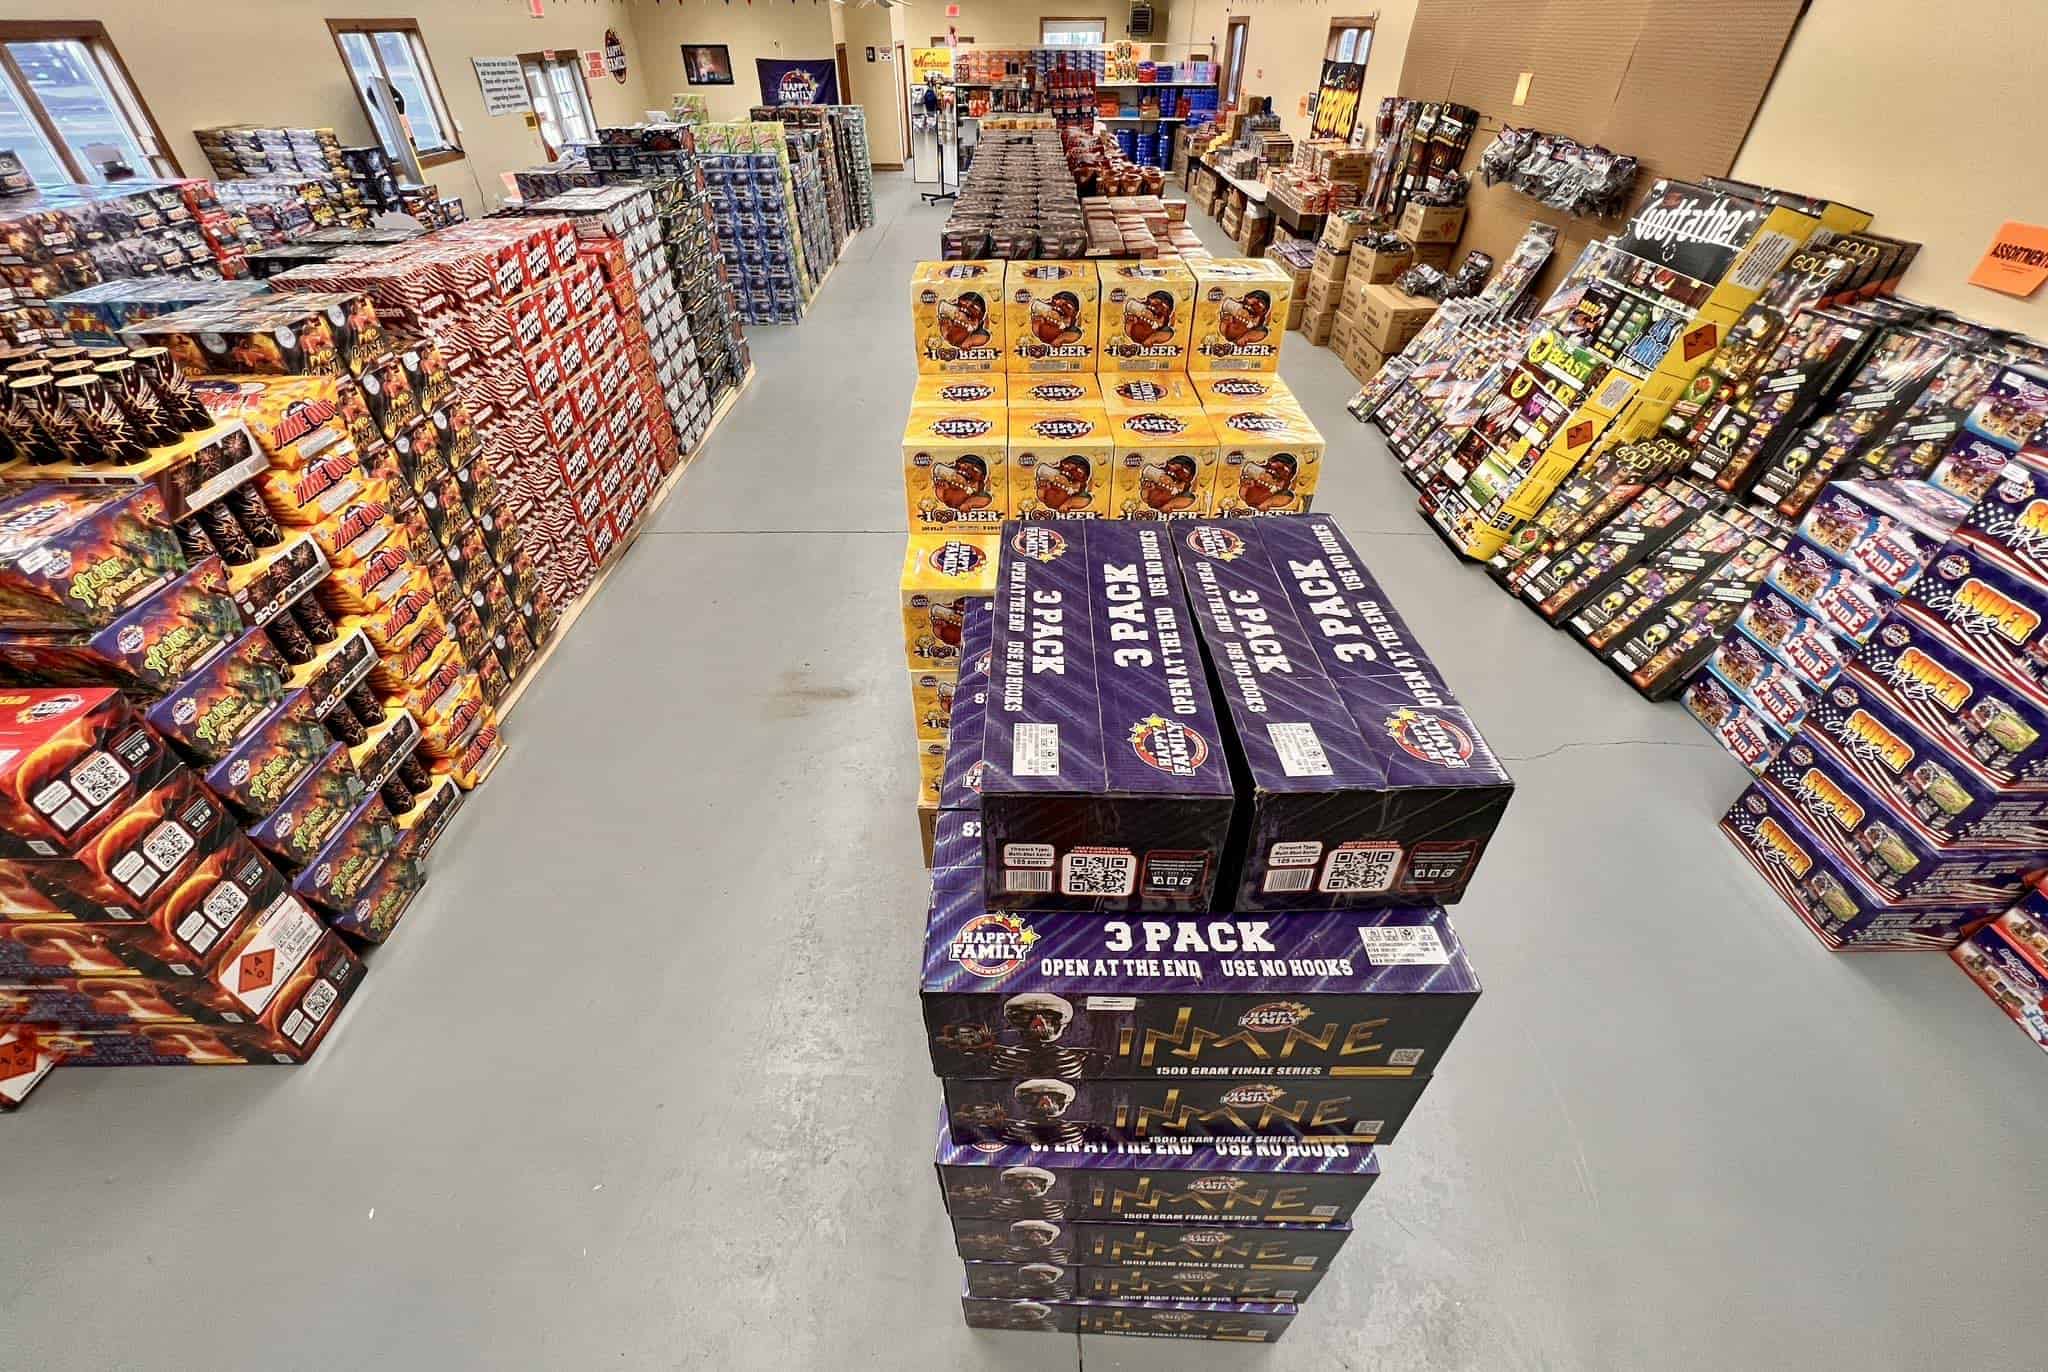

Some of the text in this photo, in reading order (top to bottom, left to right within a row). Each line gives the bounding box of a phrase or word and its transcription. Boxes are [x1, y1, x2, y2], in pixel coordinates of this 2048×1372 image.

[778, 89, 815, 101] FAMILY
[783, 82, 809, 92] HAPPY
[1632, 197, 1755, 248] Godfather
[1836, 239, 1879, 259] GOLD
[1990, 241, 2048, 268] ASSORTMEN
[1791, 254, 1832, 277] GOLD
[959, 349, 995, 360] BEER
[1049, 346, 1086, 357] BEER
[1139, 345, 1177, 356] BEER
[1232, 345, 1270, 356] BEER
[272, 399, 338, 450] TIME OUT
[1615, 446, 1651, 470] GOLD
[1638, 442, 1672, 465] GOLD
[1656, 439, 1690, 461] GOLD
[333, 502, 389, 552] TIME OUT
[957, 511, 998, 522] BEER
[1055, 511, 1096, 520] BEER
[1157, 512, 1198, 520] BEER
[1025, 527, 1039, 559] FAMILY
[1039, 529, 1049, 555] HAPPY
[1198, 526, 1218, 557] FAMILY
[1211, 529, 1227, 553] HAPPY
[943, 541, 960, 576] FAMILY
[959, 545, 970, 573] HAPPY
[1855, 540, 1907, 586] PRIDE
[384, 590, 434, 641] TIME OUT
[1103, 563, 1153, 668] 3 PACK
[1139, 530, 1197, 715] OPEN AT THE END USE NO HOOKS
[1288, 559, 1377, 663] 3 PACK
[1311, 523, 1444, 708] OPEN AT THE END USE NO HOOKS
[1927, 595, 1998, 635] CAKES
[1952, 580, 2039, 639] SUPER
[1004, 562, 1026, 712] OPEN AT THE END USE NO HOOKS
[1032, 590, 1065, 675] 3 PACK
[1196, 562, 1267, 713] OPEN AT THE END USE NO HOOKS
[1228, 590, 1293, 674] 3 PACK
[1785, 638, 1826, 683] PRIDE
[1872, 661, 1936, 701] CAKES
[1902, 648, 1972, 711] SUPER
[1152, 726, 1172, 767] HAPPY
[1165, 721, 1192, 775] FAMILY
[1408, 721, 1443, 760] HAPPY
[1421, 716, 1466, 768] FAMILY
[1720, 722, 1759, 769] PRIDE
[1782, 778, 1834, 818] CAKES
[1802, 769, 1864, 831] SUPER
[1740, 825, 1786, 865] CAKES
[1758, 818, 1812, 879] SUPER
[952, 944, 1028, 959] FAMILY
[962, 931, 1020, 944] HAPPY
[1104, 921, 1276, 953] 3 PACK
[1041, 959, 1354, 977] OPEN AT THE END USE NO HOOKS
[1240, 1016, 1300, 1025] FAMILY
[1248, 1010, 1296, 1018] HAPPY
[1156, 1066, 1321, 1075] 1500 GRAM FINALE SERIES
[1221, 1095, 1280, 1103] FAMILY
[1180, 1136, 1213, 1144] GRAM
[1255, 1136, 1296, 1144] SERIES
[1185, 1213, 1220, 1221] FINALE
[1179, 1260, 1210, 1268] FINALE
[1212, 1261, 1245, 1269] SERIES
